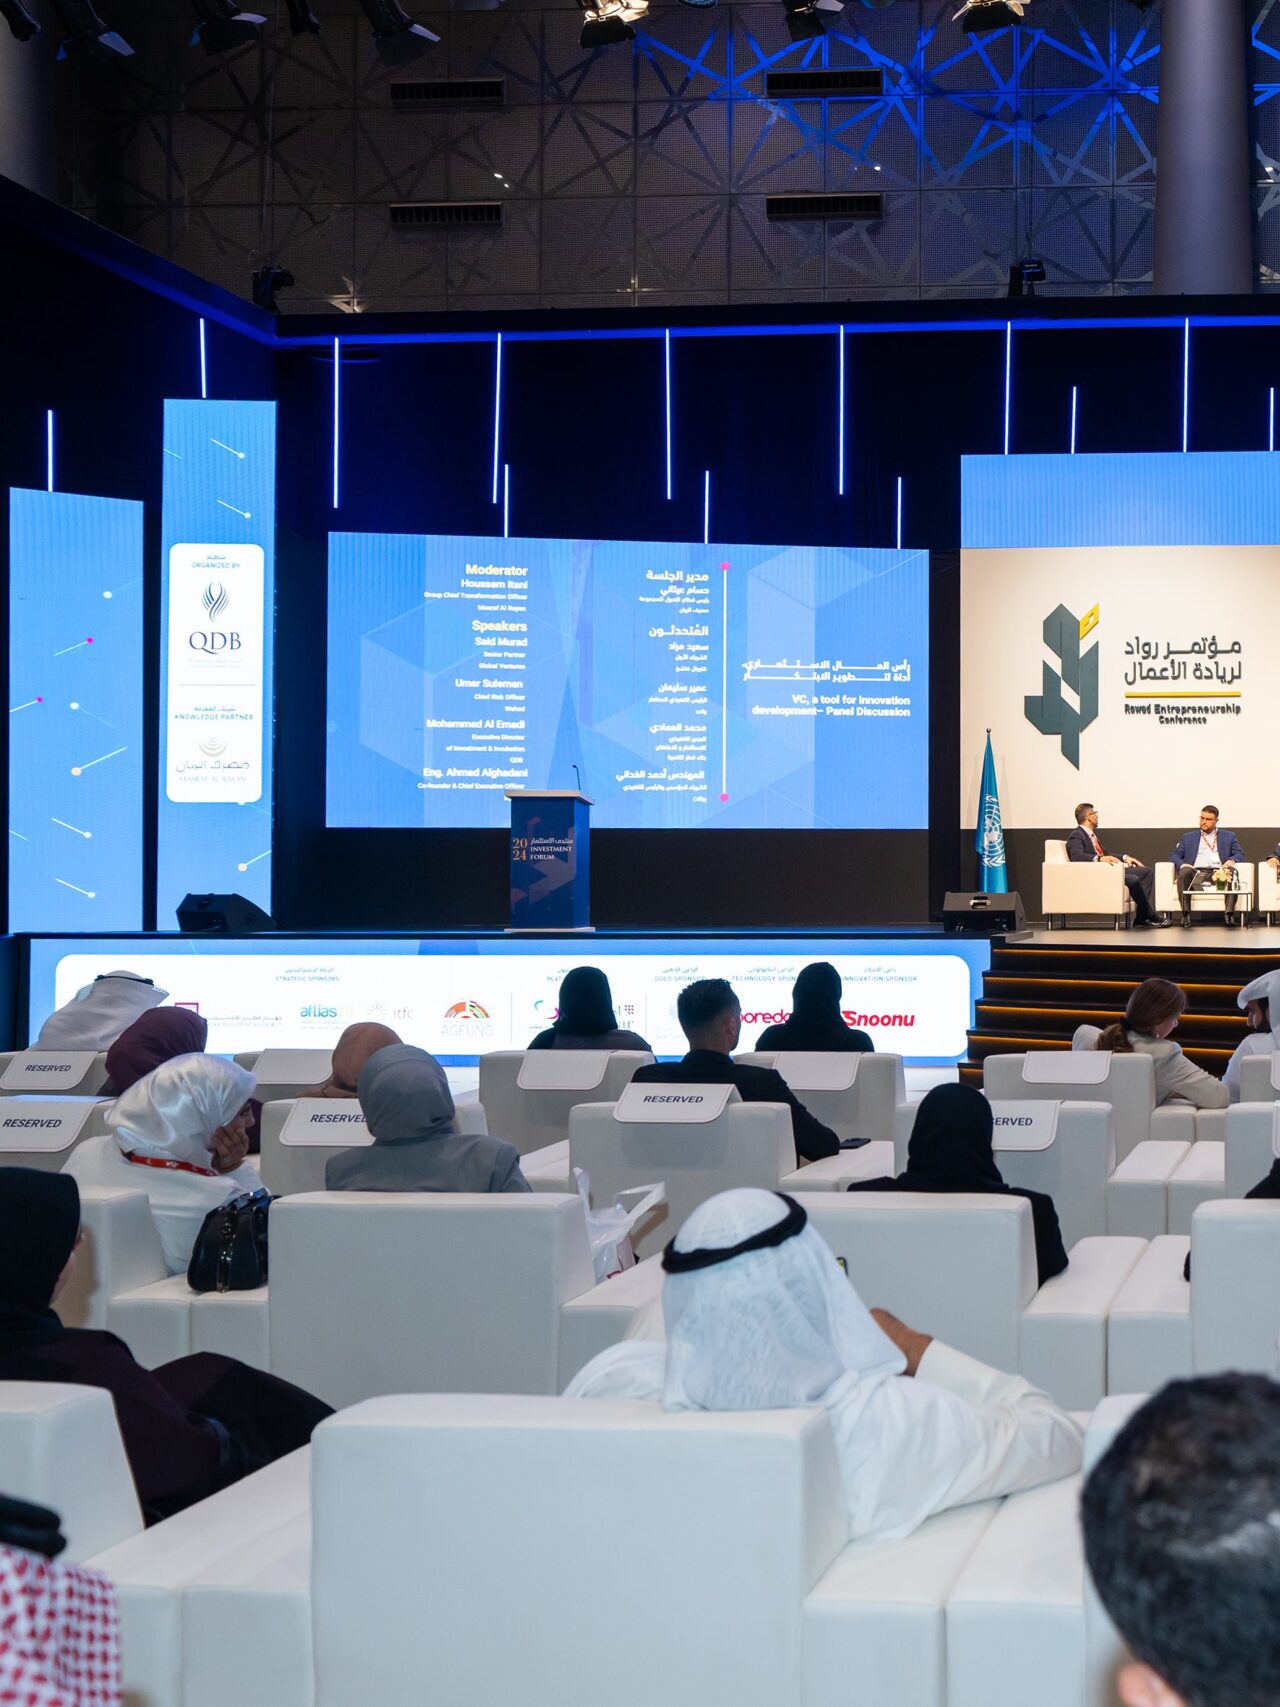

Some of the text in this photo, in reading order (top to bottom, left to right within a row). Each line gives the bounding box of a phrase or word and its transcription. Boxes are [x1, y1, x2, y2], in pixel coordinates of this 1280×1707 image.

[466, 564, 528, 576] Moderator
[646, 570, 709, 583] مدير الجلسة
[461, 579, 528, 589] Houssam Itani
[472, 620, 527, 633] Speakers
[189, 631, 241, 654] QDB
[475, 637, 527, 646] Said Murad
[1124, 636, 1242, 659] مؤتمر رواد
[1124, 661, 1242, 685] لريادة الأعمال
[455, 679, 523, 688] Umer Suleman
[792, 695, 809, 705] VC,
[821, 695, 839, 704] tool
[842, 695, 856, 704] for
[859, 696, 910, 705] innovation
[826, 707, 854, 716] Panel
[856, 708, 910, 716] Discussion
[1154, 703, 1242, 716] Entrepreneurship
[426, 720, 482, 728] Mohammed
[497, 721, 525, 729] Emadi
[1158, 715, 1207, 724] Conference
[685, 724, 706, 732] محمد
[423, 768, 444, 778] Eng.
[446, 769, 480, 777] Ahmed
[513, 838, 528, 849] 20
[513, 850, 527, 861] 24
[842, 1011, 915, 1027] Snoonu
[441, 1024, 494, 1037] AGFUND
[24, 1064, 72, 1072] RESERVED
[643, 1095, 704, 1104] RESERVED
[2, 1118, 62, 1128] RESERVED
[992, 1117, 1033, 1126] ERVED
